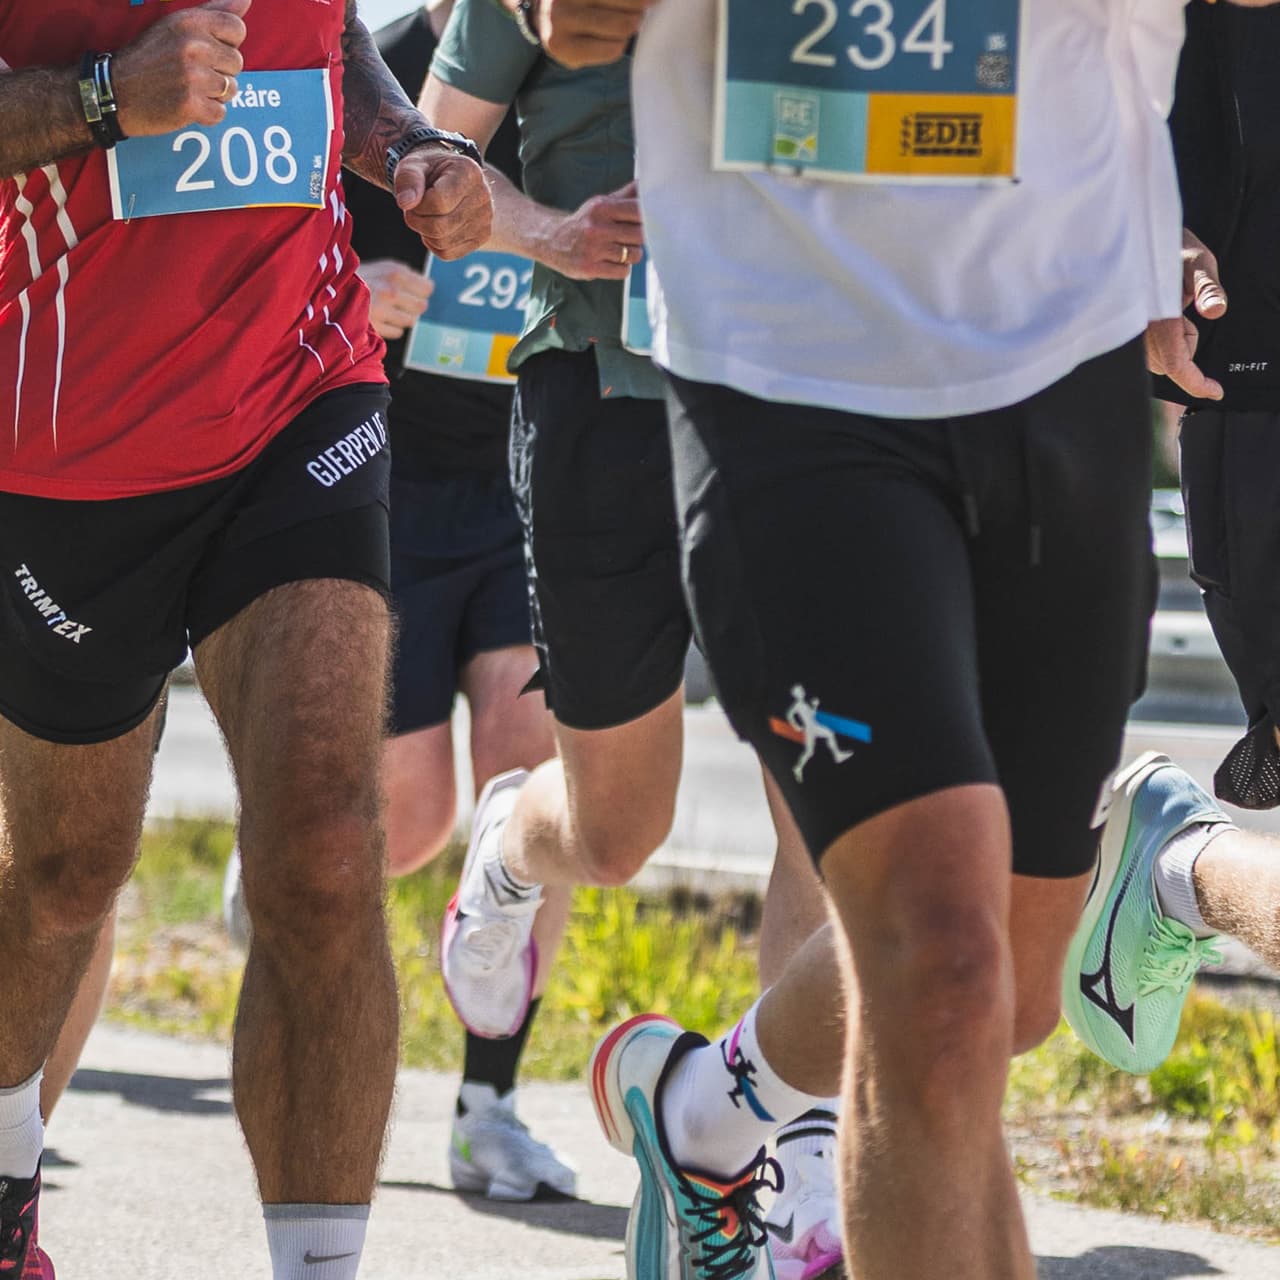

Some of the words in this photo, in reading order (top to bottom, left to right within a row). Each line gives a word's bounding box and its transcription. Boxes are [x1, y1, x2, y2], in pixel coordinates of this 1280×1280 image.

[172, 125, 298, 192] 208
[914, 122, 981, 145] EDH
[307, 421, 382, 487] GJERPEN
[14, 563, 93, 644] TRIMTEX
